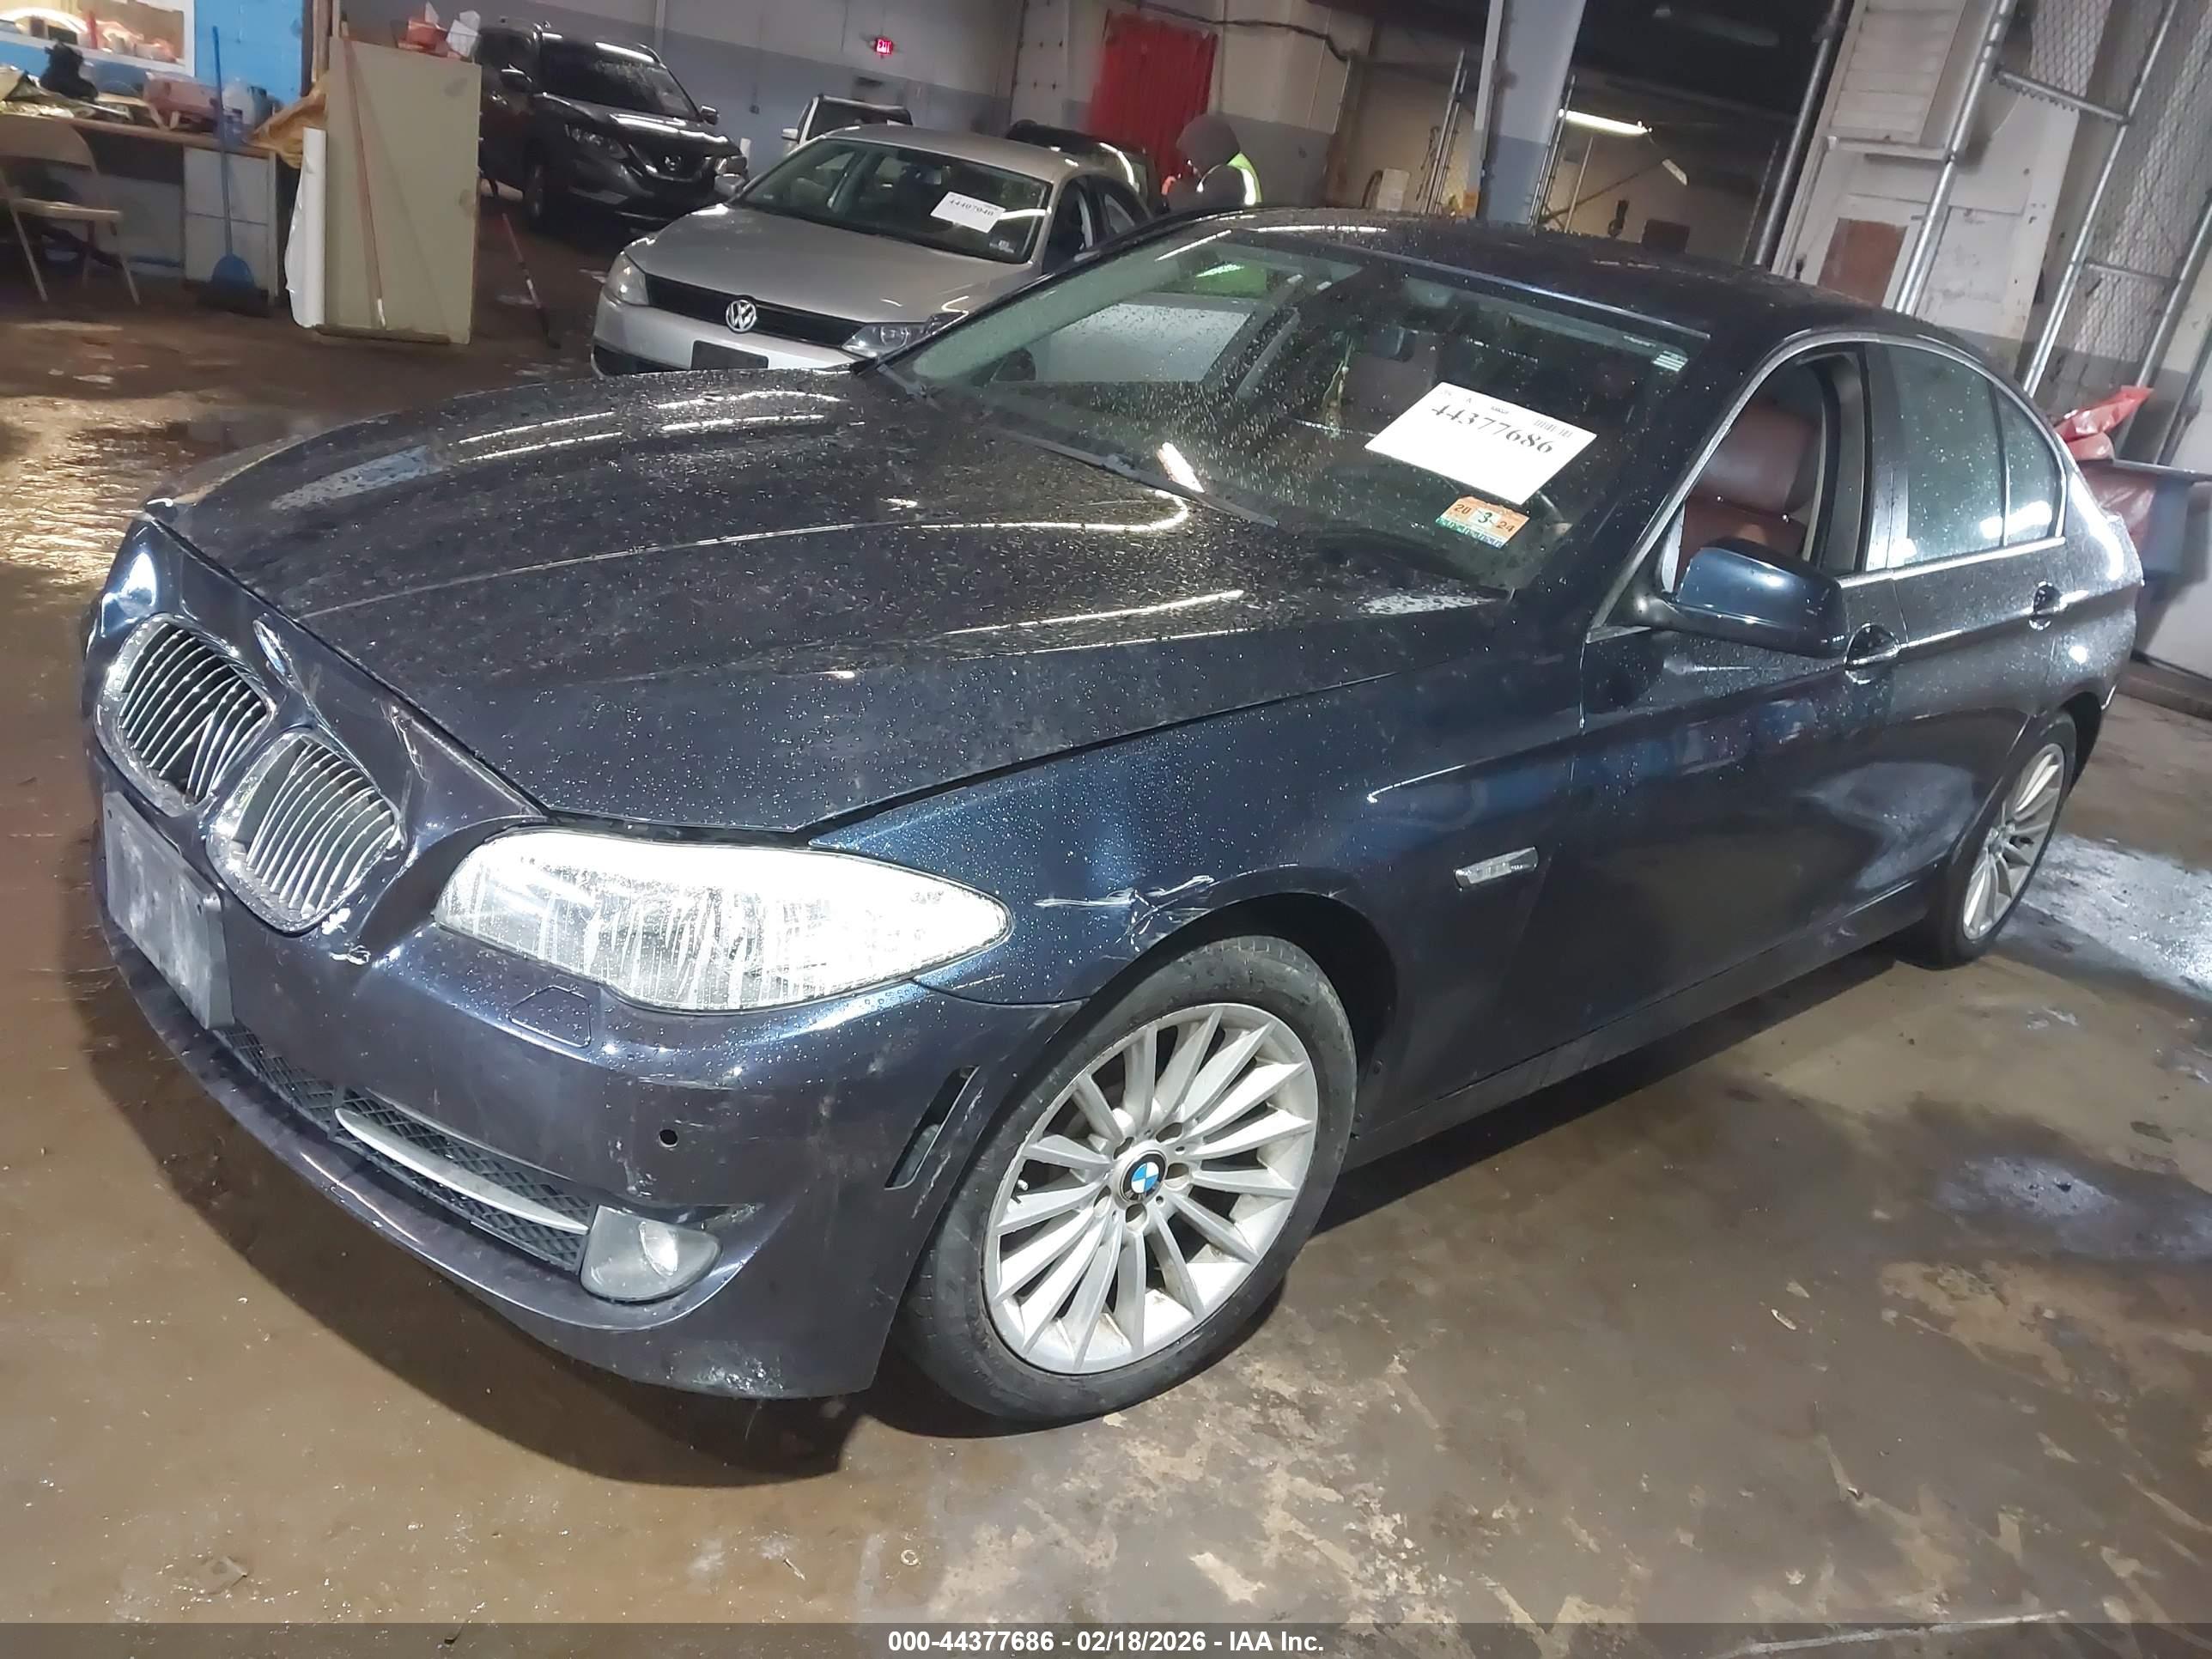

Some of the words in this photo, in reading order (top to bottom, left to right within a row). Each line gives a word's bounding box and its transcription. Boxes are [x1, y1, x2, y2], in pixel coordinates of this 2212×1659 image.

[1431, 404, 1554, 453] 44377686
[1477, 511, 1493, 524] 3
[1496, 520, 1516, 533] 24
